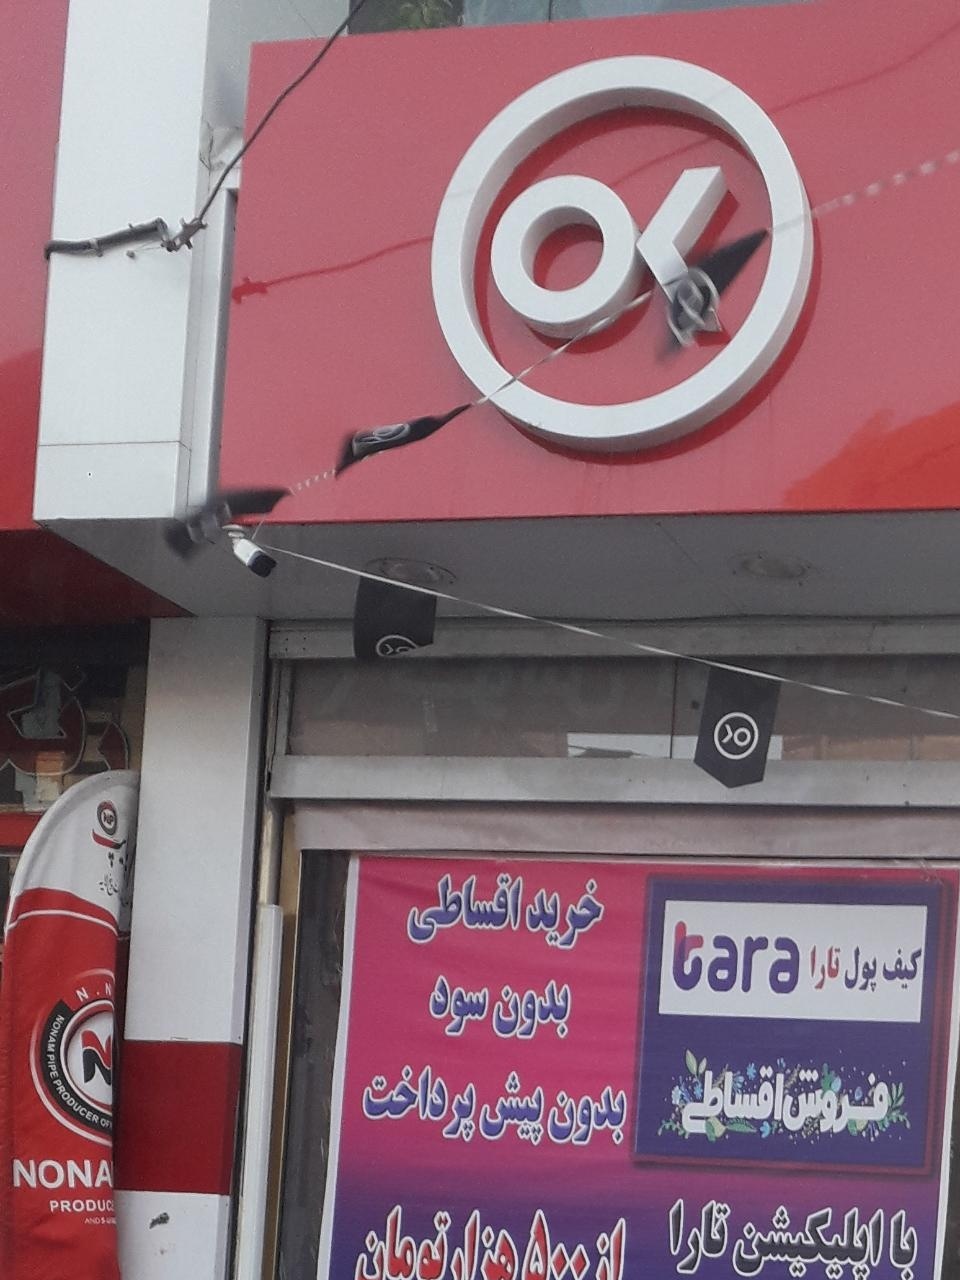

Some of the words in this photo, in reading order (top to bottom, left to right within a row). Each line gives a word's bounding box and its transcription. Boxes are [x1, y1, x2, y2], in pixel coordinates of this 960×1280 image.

[407, 873, 522, 943] اقساطی
[526, 879, 604, 948] خرید
[672, 921, 800, 994] tara
[810, 945, 841, 990] تارا
[844, 946, 877, 992] پول
[882, 946, 923, 989] کیف
[430, 975, 488, 1035] سود
[493, 981, 571, 1038] بدون
[47, 1054, 59, 1079] PIPE
[52, 1080, 99, 1125] PRODUCER
[362, 1065, 475, 1141] پرداخت
[480, 1071, 543, 1144] پیش
[549, 1087, 626, 1144] بدون
[682, 1065, 784, 1133] اقساطی
[783, 1068, 889, 1133] فروش
[13, 1159, 113, 1189] NONA
[669, 1199, 730, 1275] تارا
